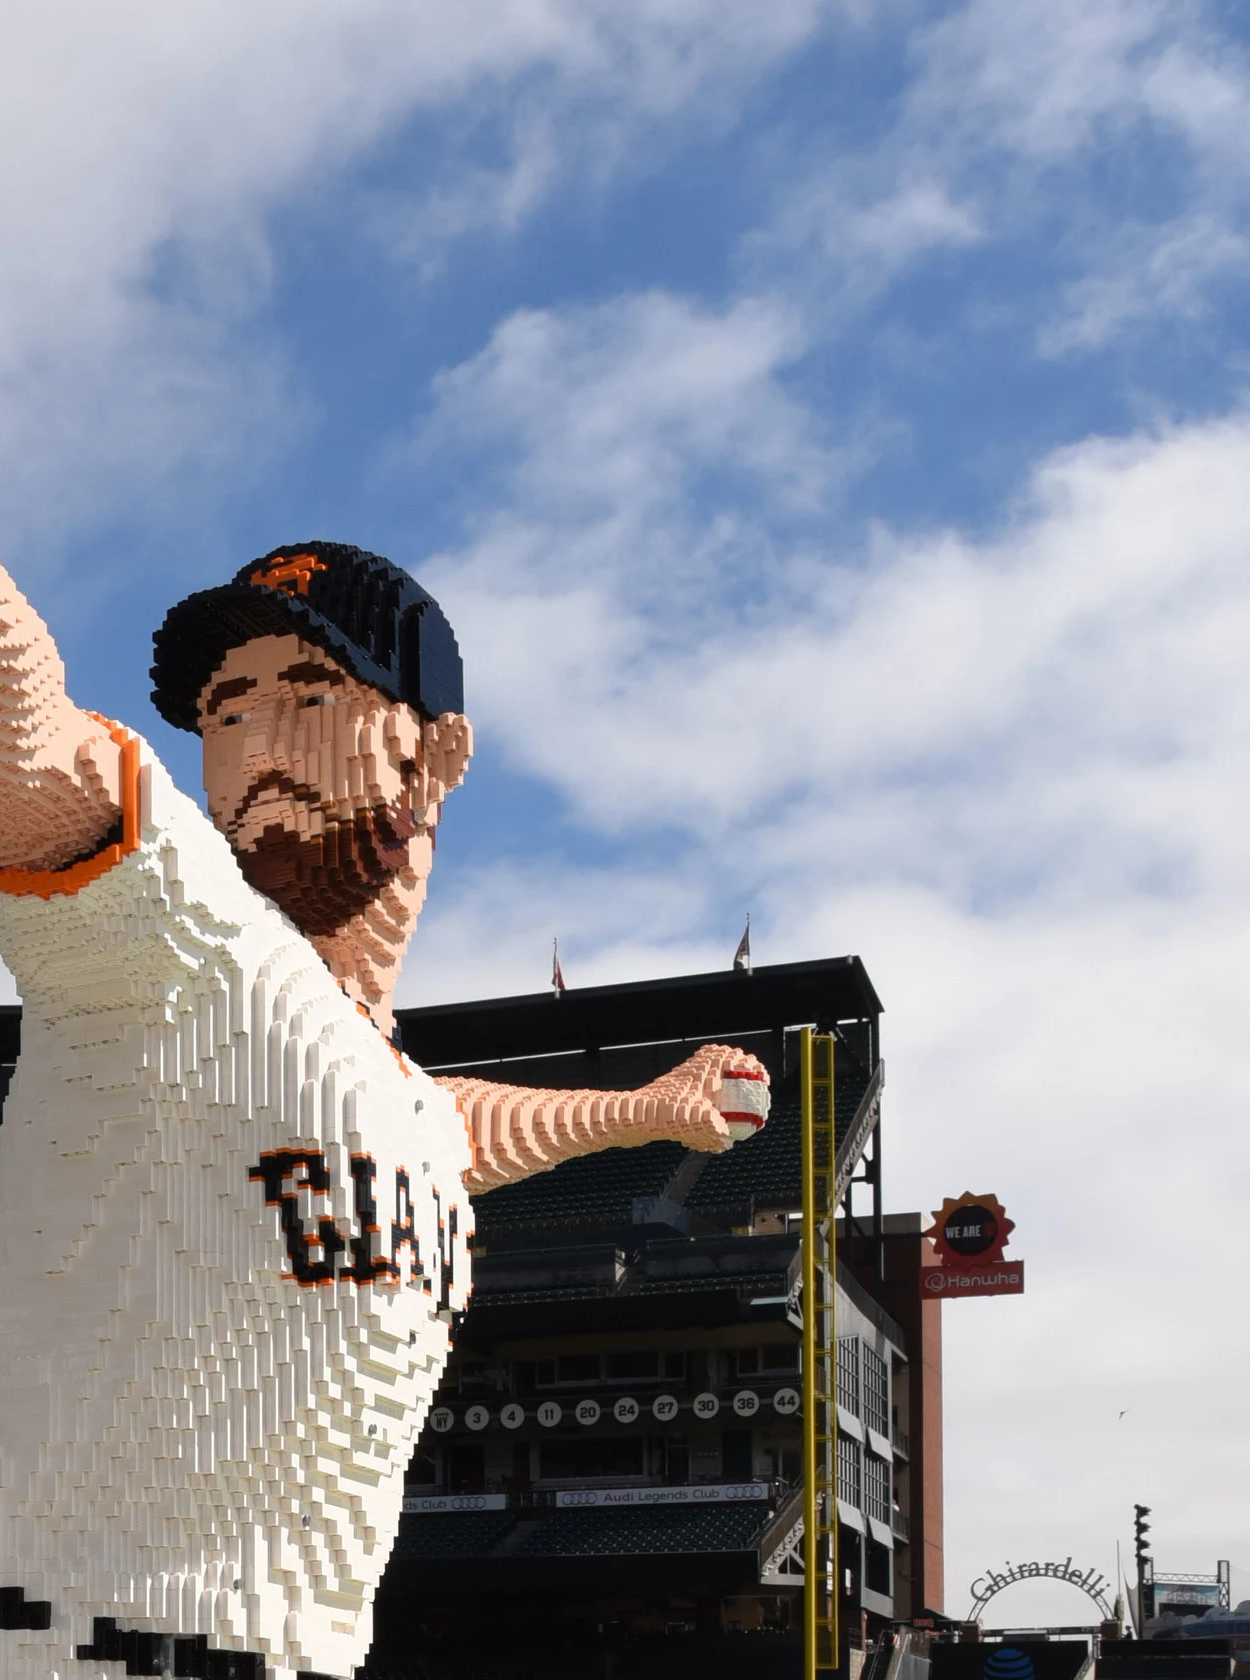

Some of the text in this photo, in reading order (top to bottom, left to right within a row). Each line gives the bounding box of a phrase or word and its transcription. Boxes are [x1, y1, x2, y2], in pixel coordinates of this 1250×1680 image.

[945, 1226, 961, 1240] WE
[962, 1224, 982, 1238] ARE
[948, 1273, 1020, 1288] Hanwha
[697, 1400, 715, 1412] 30
[777, 1395, 796, 1407] 44
[580, 1407, 596, 1418] 20
[618, 1405, 636, 1416] 24
[657, 1402, 674, 1414] 27
[473, 1413, 481, 1423] 3
[507, 1411, 516, 1422] 4
[544, 1409, 554, 1420] 11
[604, 1488, 720, 1503] Audi Legends Club
[970, 1557, 1111, 1602] Ghirardelli
